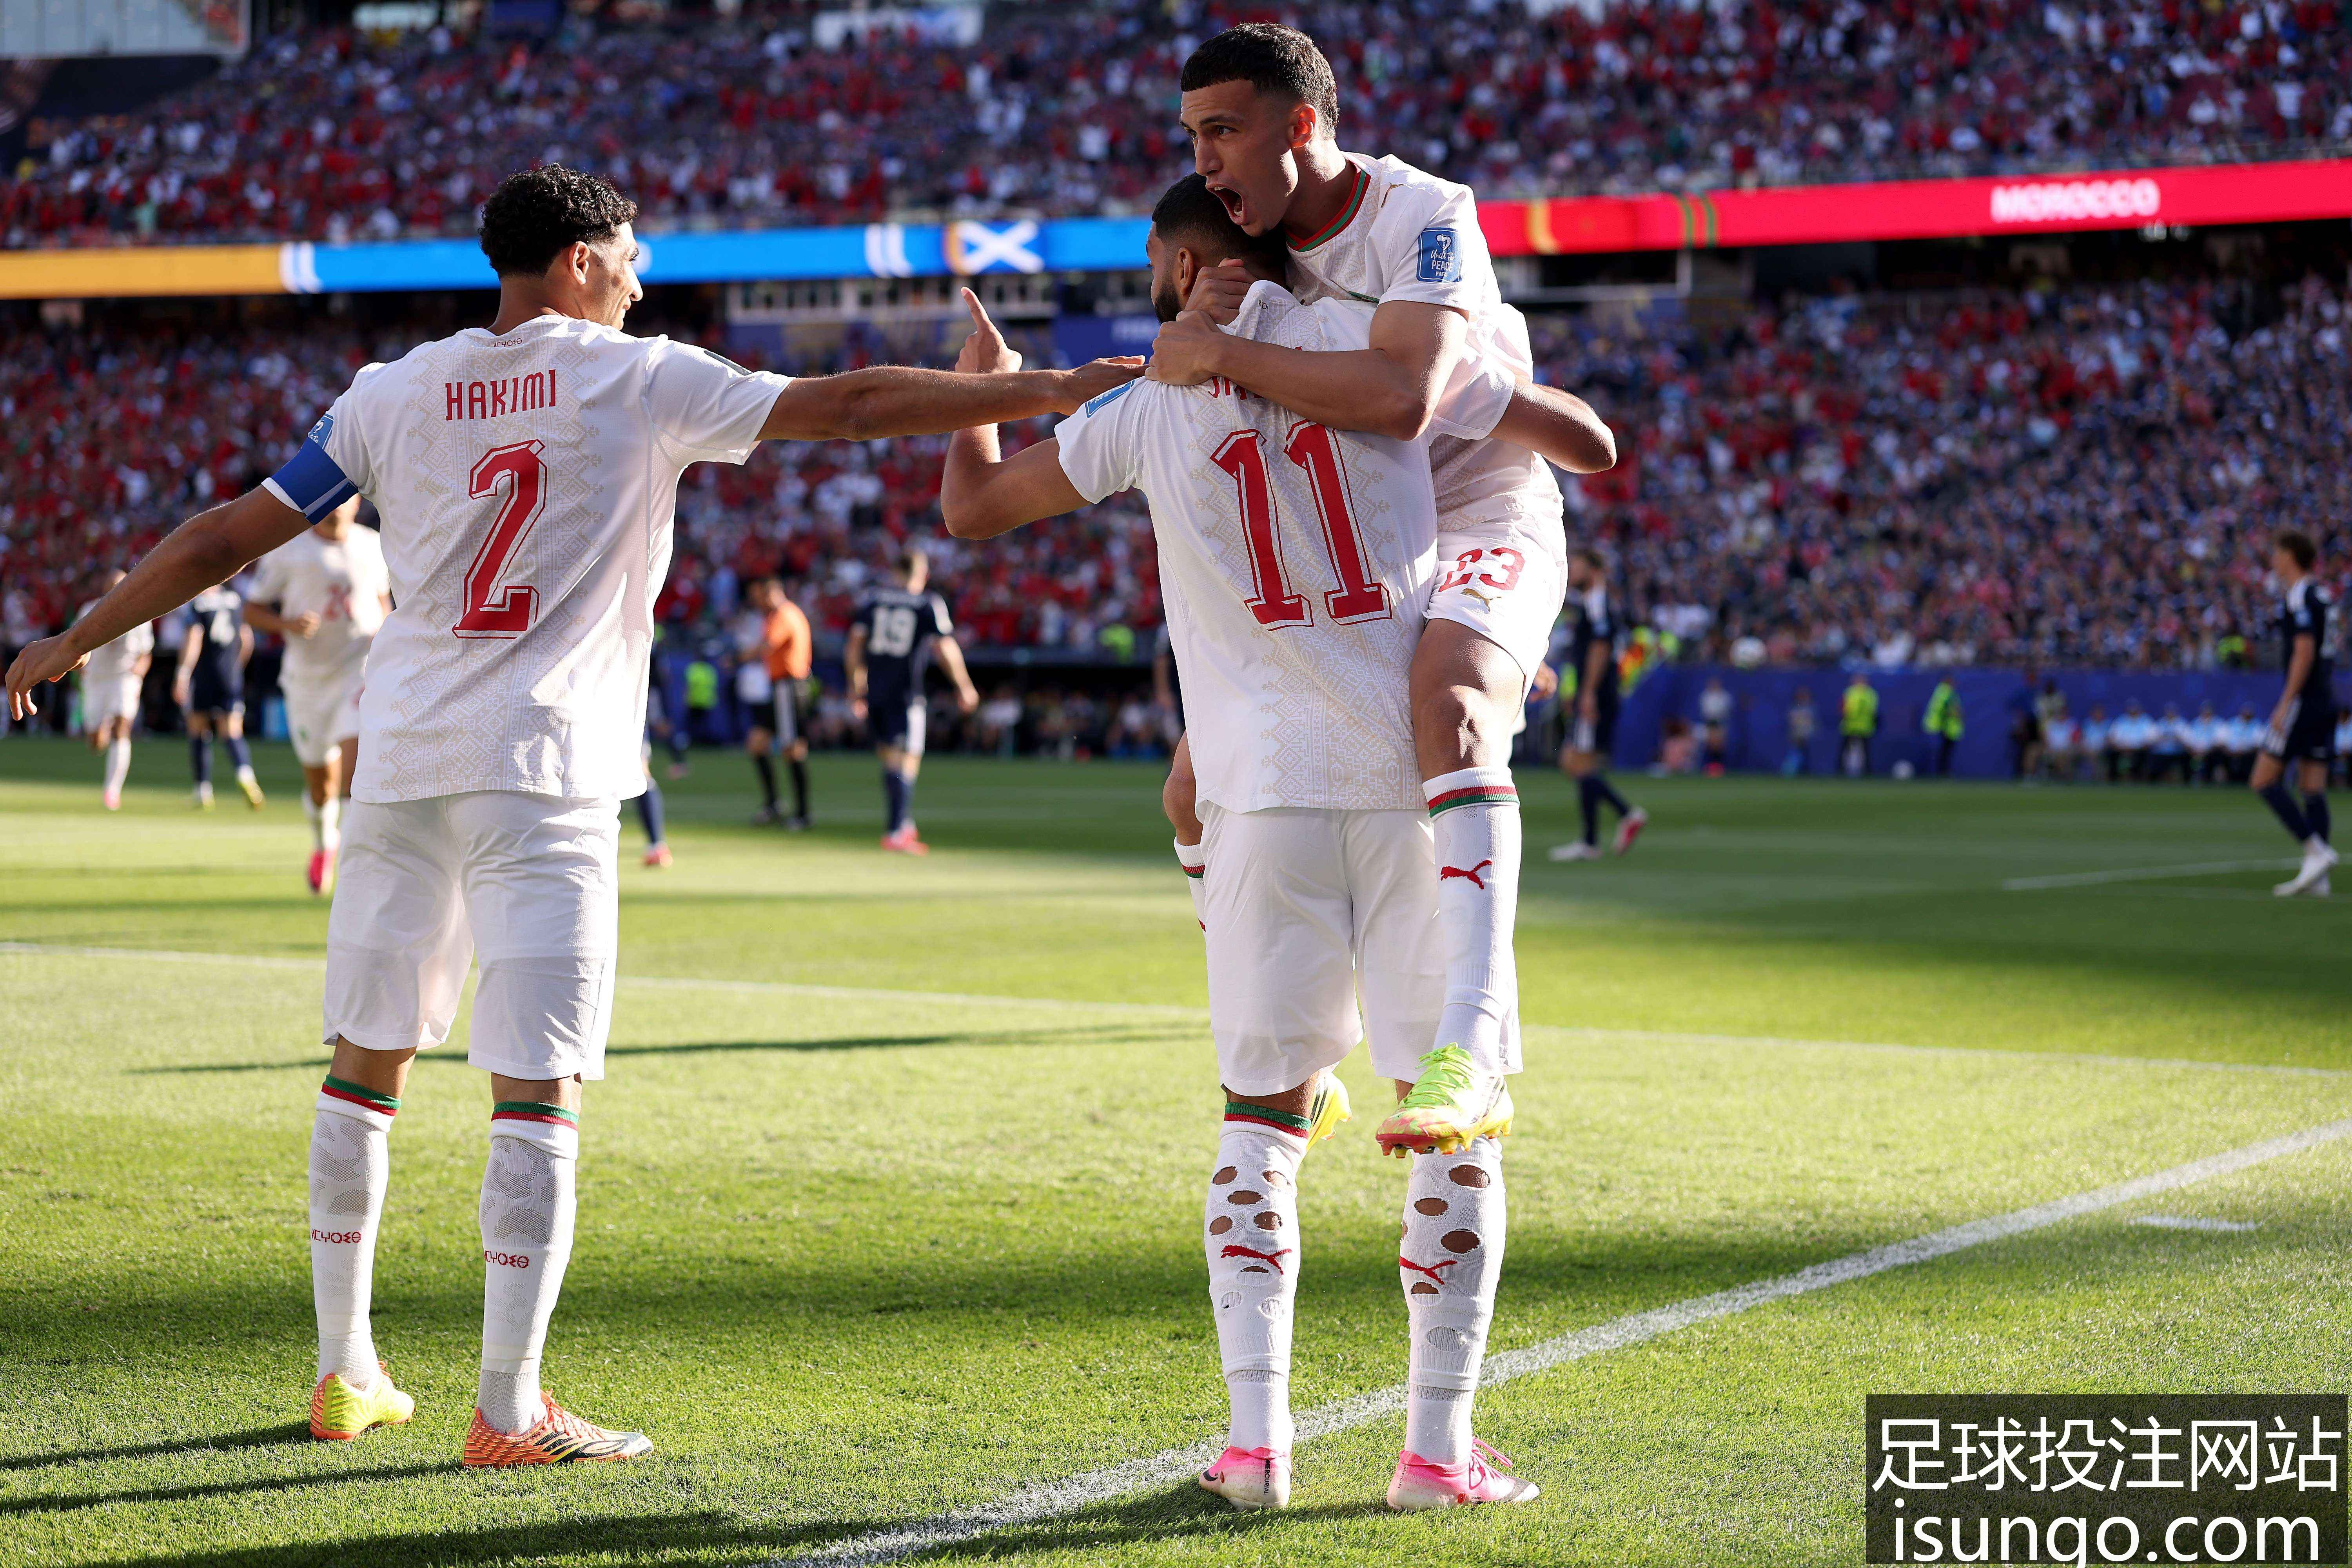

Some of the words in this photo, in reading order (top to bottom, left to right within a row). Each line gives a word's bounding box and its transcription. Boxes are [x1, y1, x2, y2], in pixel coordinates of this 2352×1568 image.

[1991, 178, 2160, 223] MOROCCO
[1432, 260, 1453, 272] PEACE
[445, 370, 556, 421] HAKIMI
[452, 439, 547, 639] 2
[1210, 419, 1393, 632] 11
[1438, 547, 1526, 593] 23
[868, 606, 918, 657] 19
[1397, 1465, 1408, 1488] VAPOR
